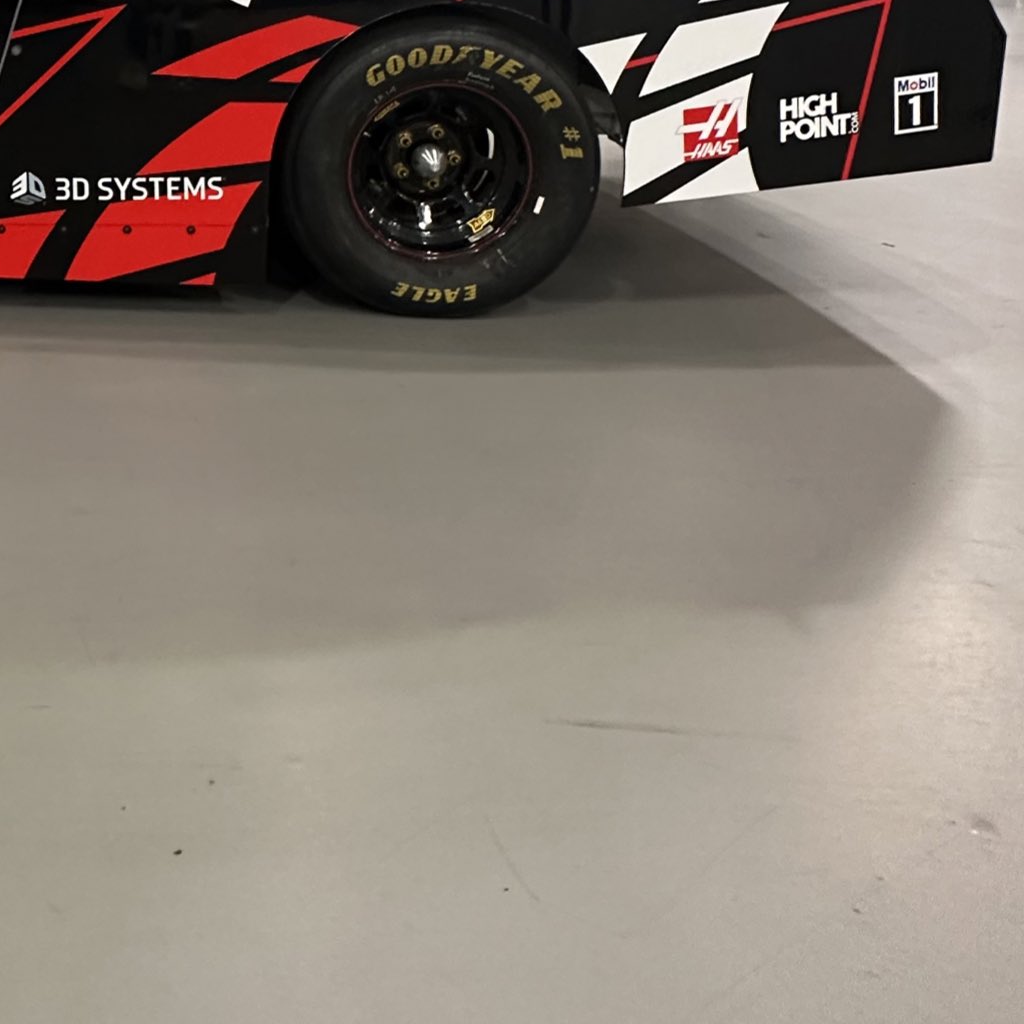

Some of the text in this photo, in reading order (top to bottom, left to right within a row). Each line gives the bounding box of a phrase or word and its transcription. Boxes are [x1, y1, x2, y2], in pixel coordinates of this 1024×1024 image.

[365, 44, 562, 113] GOODYEAR
[897, 76, 936, 93] Mobil
[779, 92, 838, 120] HIGH
[907, 95, 922, 127] 1
[779, 113, 851, 143] POINT
[560, 126, 584, 160] #1
[684, 138, 739, 160] HAAS
[55, 177, 90, 201] 3D
[97, 176, 224, 201] SYSTEMS
[390, 281, 477, 304] EAGLE
